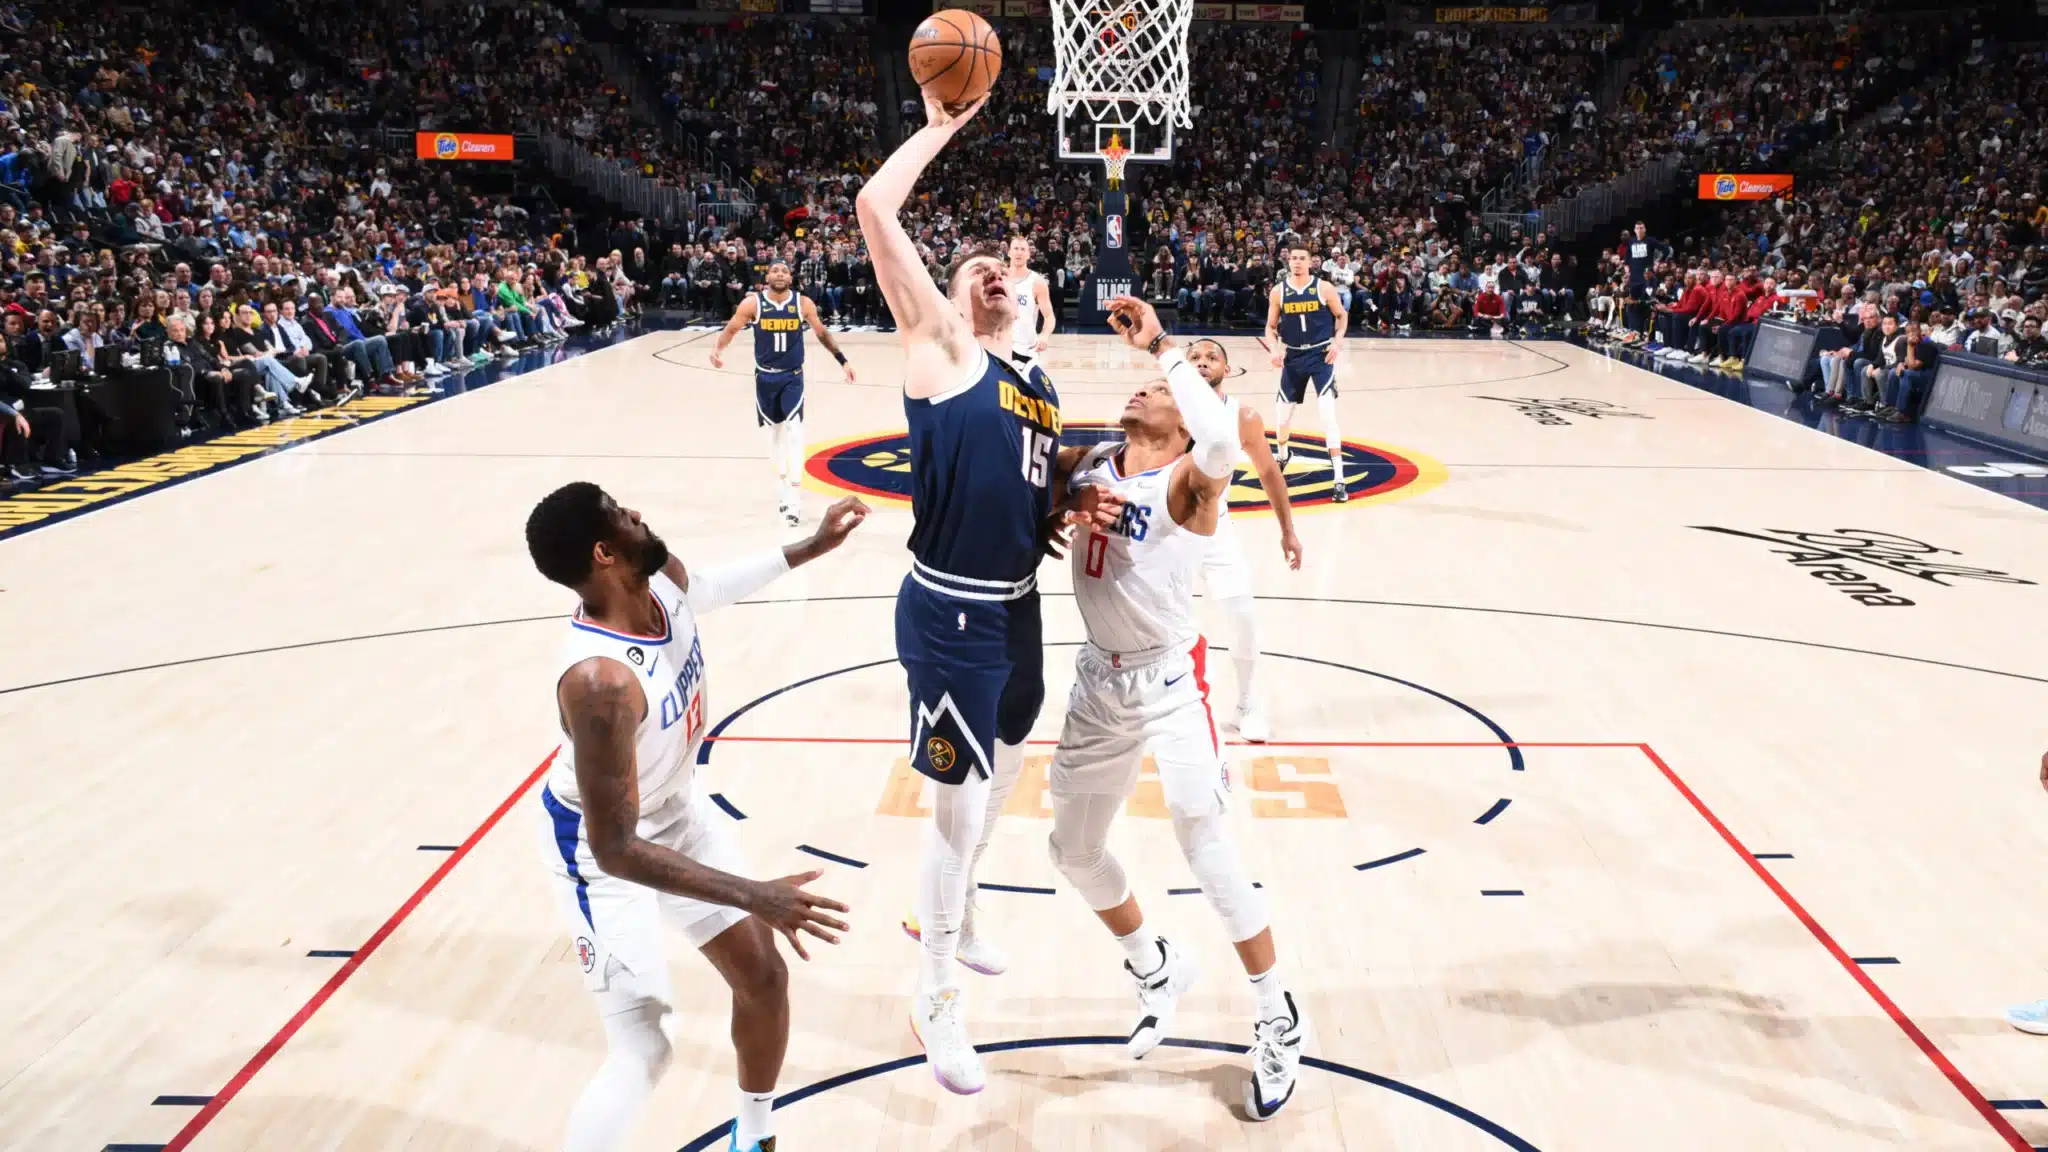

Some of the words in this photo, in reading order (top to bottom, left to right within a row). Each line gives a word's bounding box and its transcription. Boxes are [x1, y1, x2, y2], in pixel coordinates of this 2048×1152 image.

[437, 138, 457, 154] Tide
[461, 140, 496, 152] Cleaners
[1717, 180, 1735, 196] Tide
[1739, 180, 1773, 192] Cleaners
[1096, 283, 1132, 300] BLACK
[1284, 301, 1319, 314] DENVER
[760, 318, 799, 331] DENVER
[1299, 314, 1307, 332] 1
[773, 332, 787, 352] 11
[999, 380, 1062, 436] DENVE
[1509, 404, 1573, 426] Arena
[1022, 425, 1053, 488] 15
[1085, 531, 1109, 579] 0
[1684, 526, 2040, 587] Ball
[1768, 549, 1917, 607] Arena
[661, 634, 705, 731] CLIPPER
